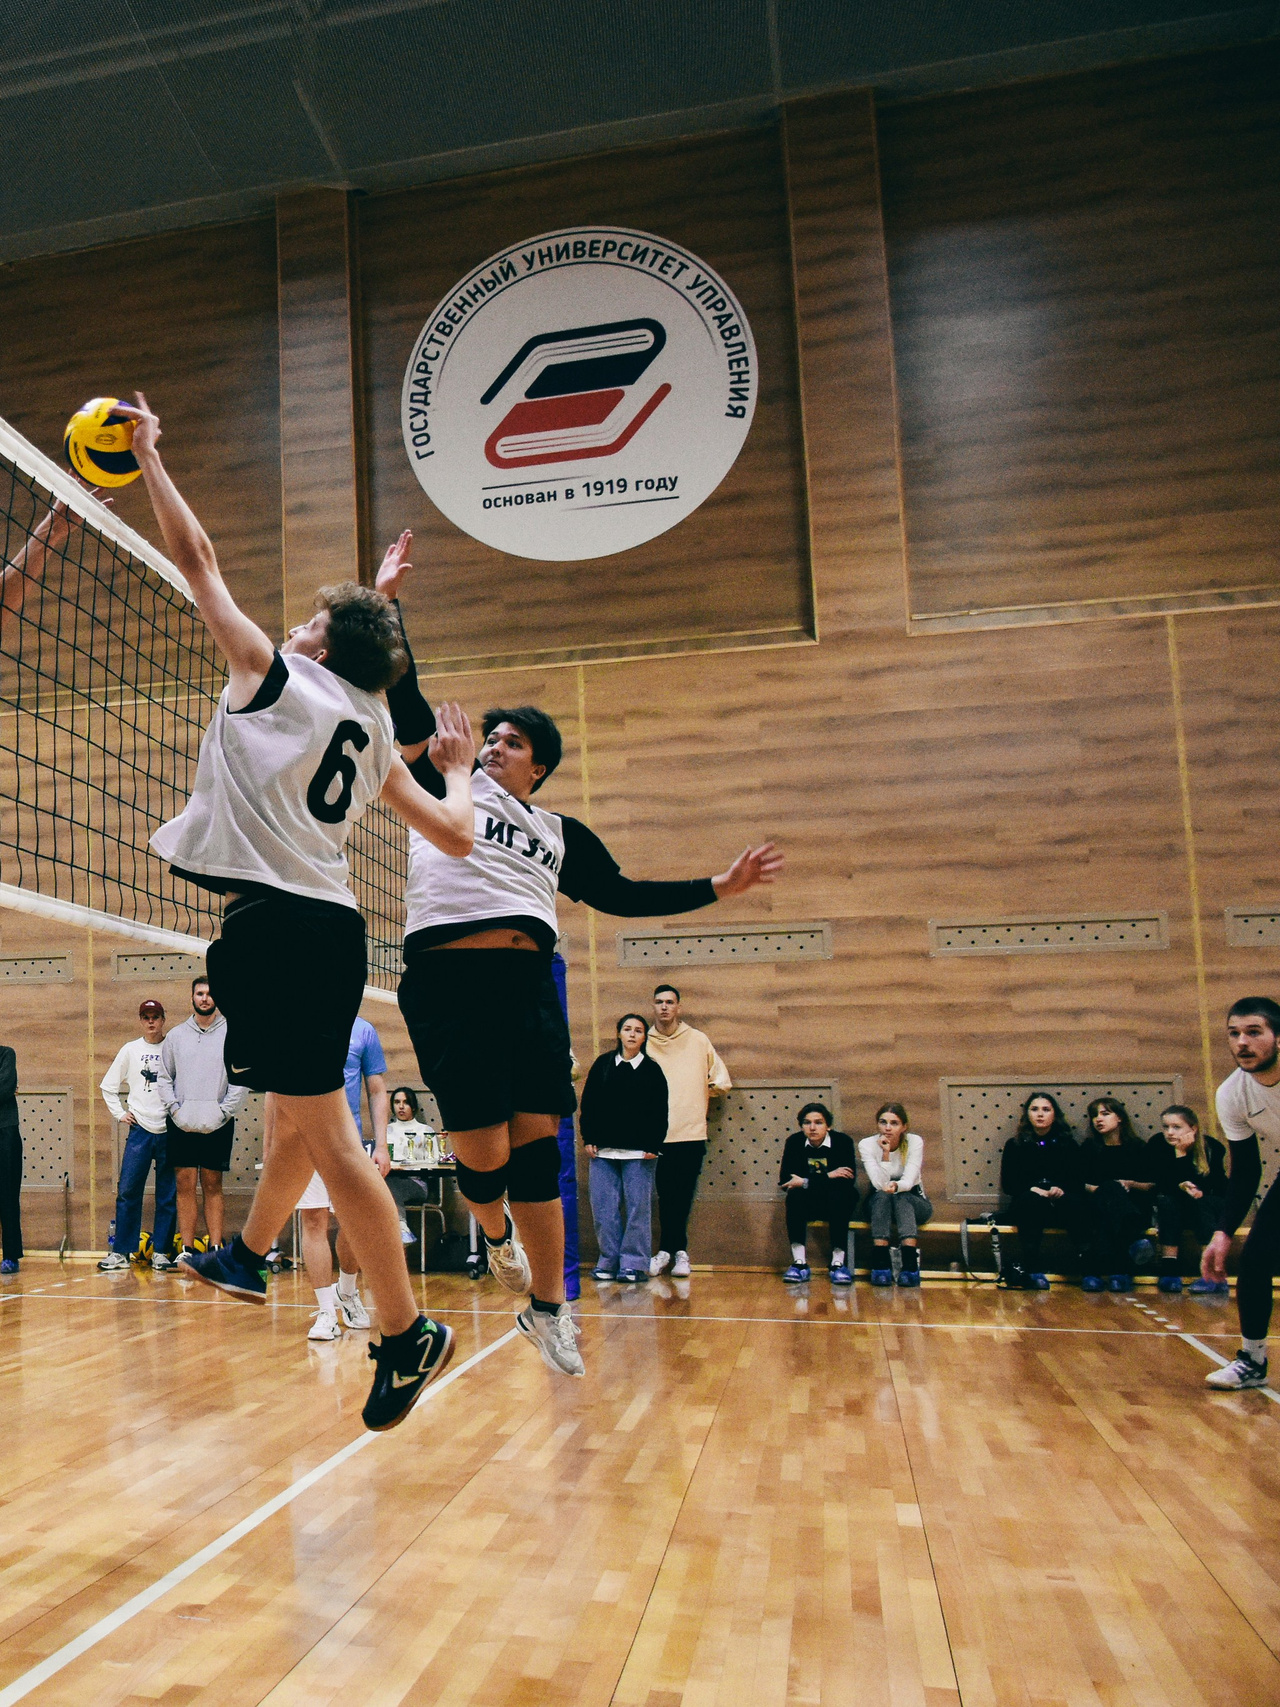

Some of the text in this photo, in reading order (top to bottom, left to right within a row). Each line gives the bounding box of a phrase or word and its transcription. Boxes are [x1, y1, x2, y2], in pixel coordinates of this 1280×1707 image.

[410, 239, 750, 460] ГОСУДАРСТВЕННЫЙ УНИВЕРСИТЕТ УПРАВЛЕНИЯ
[482, 475, 679, 509] основан в 1919 году
[307, 719, 370, 824] 6
